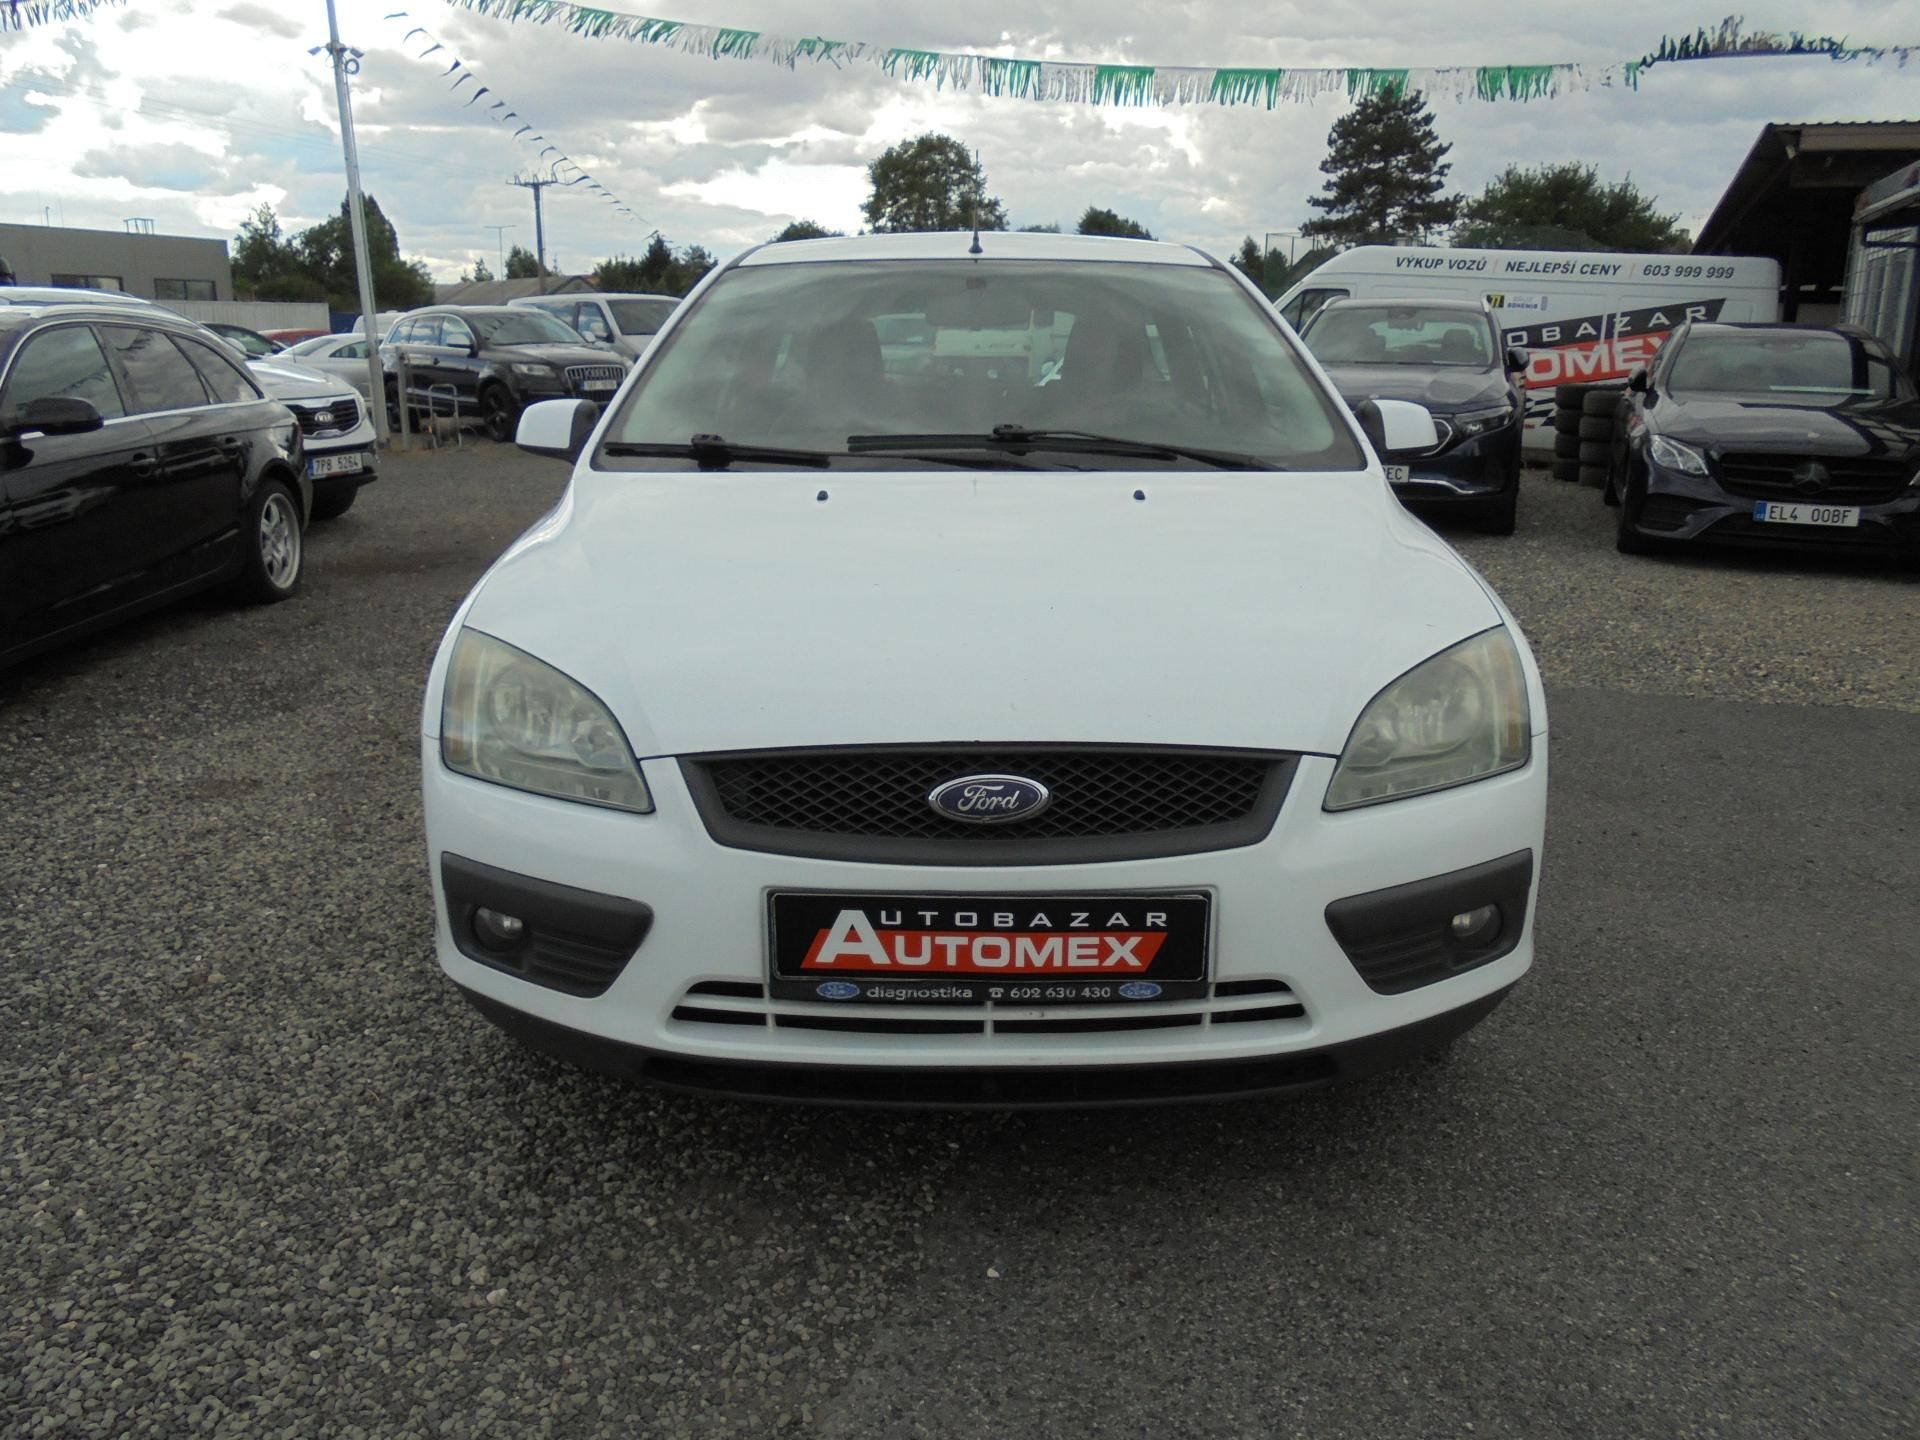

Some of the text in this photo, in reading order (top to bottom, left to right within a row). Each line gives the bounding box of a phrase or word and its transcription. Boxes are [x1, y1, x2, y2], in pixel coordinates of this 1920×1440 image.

[1395, 254, 1444, 270] VÝKUP
[1505, 259, 1622, 276] NEJLEPŠÍ CENY
[1642, 264, 1735, 280] 603 999 999
[1768, 505, 1799, 521] EL4
[957, 784, 1021, 812] Ford
[866, 985, 973, 1001] diagnostika
[1010, 987, 1112, 999] 602 630 430
